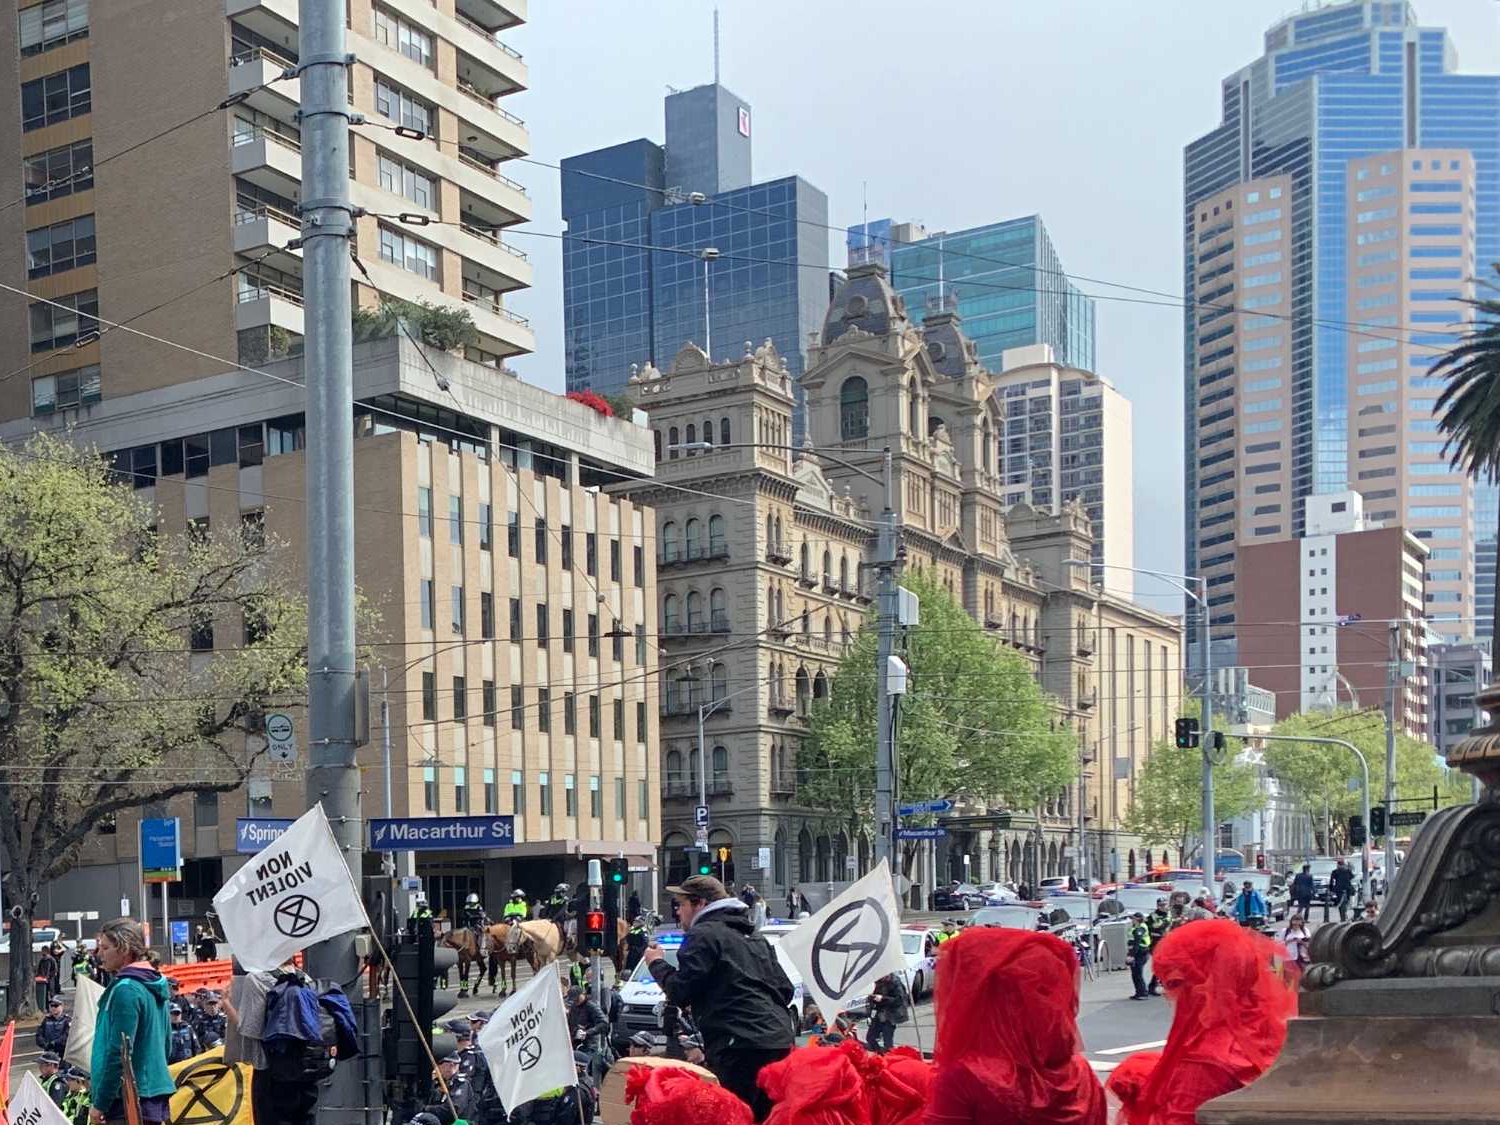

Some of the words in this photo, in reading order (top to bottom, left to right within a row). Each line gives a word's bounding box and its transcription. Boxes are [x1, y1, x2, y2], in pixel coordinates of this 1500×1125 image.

[272, 743, 293, 751] ONLY
[697, 807, 707, 821] P
[390, 822, 486, 840] Macarthur
[491, 821, 511, 838] St
